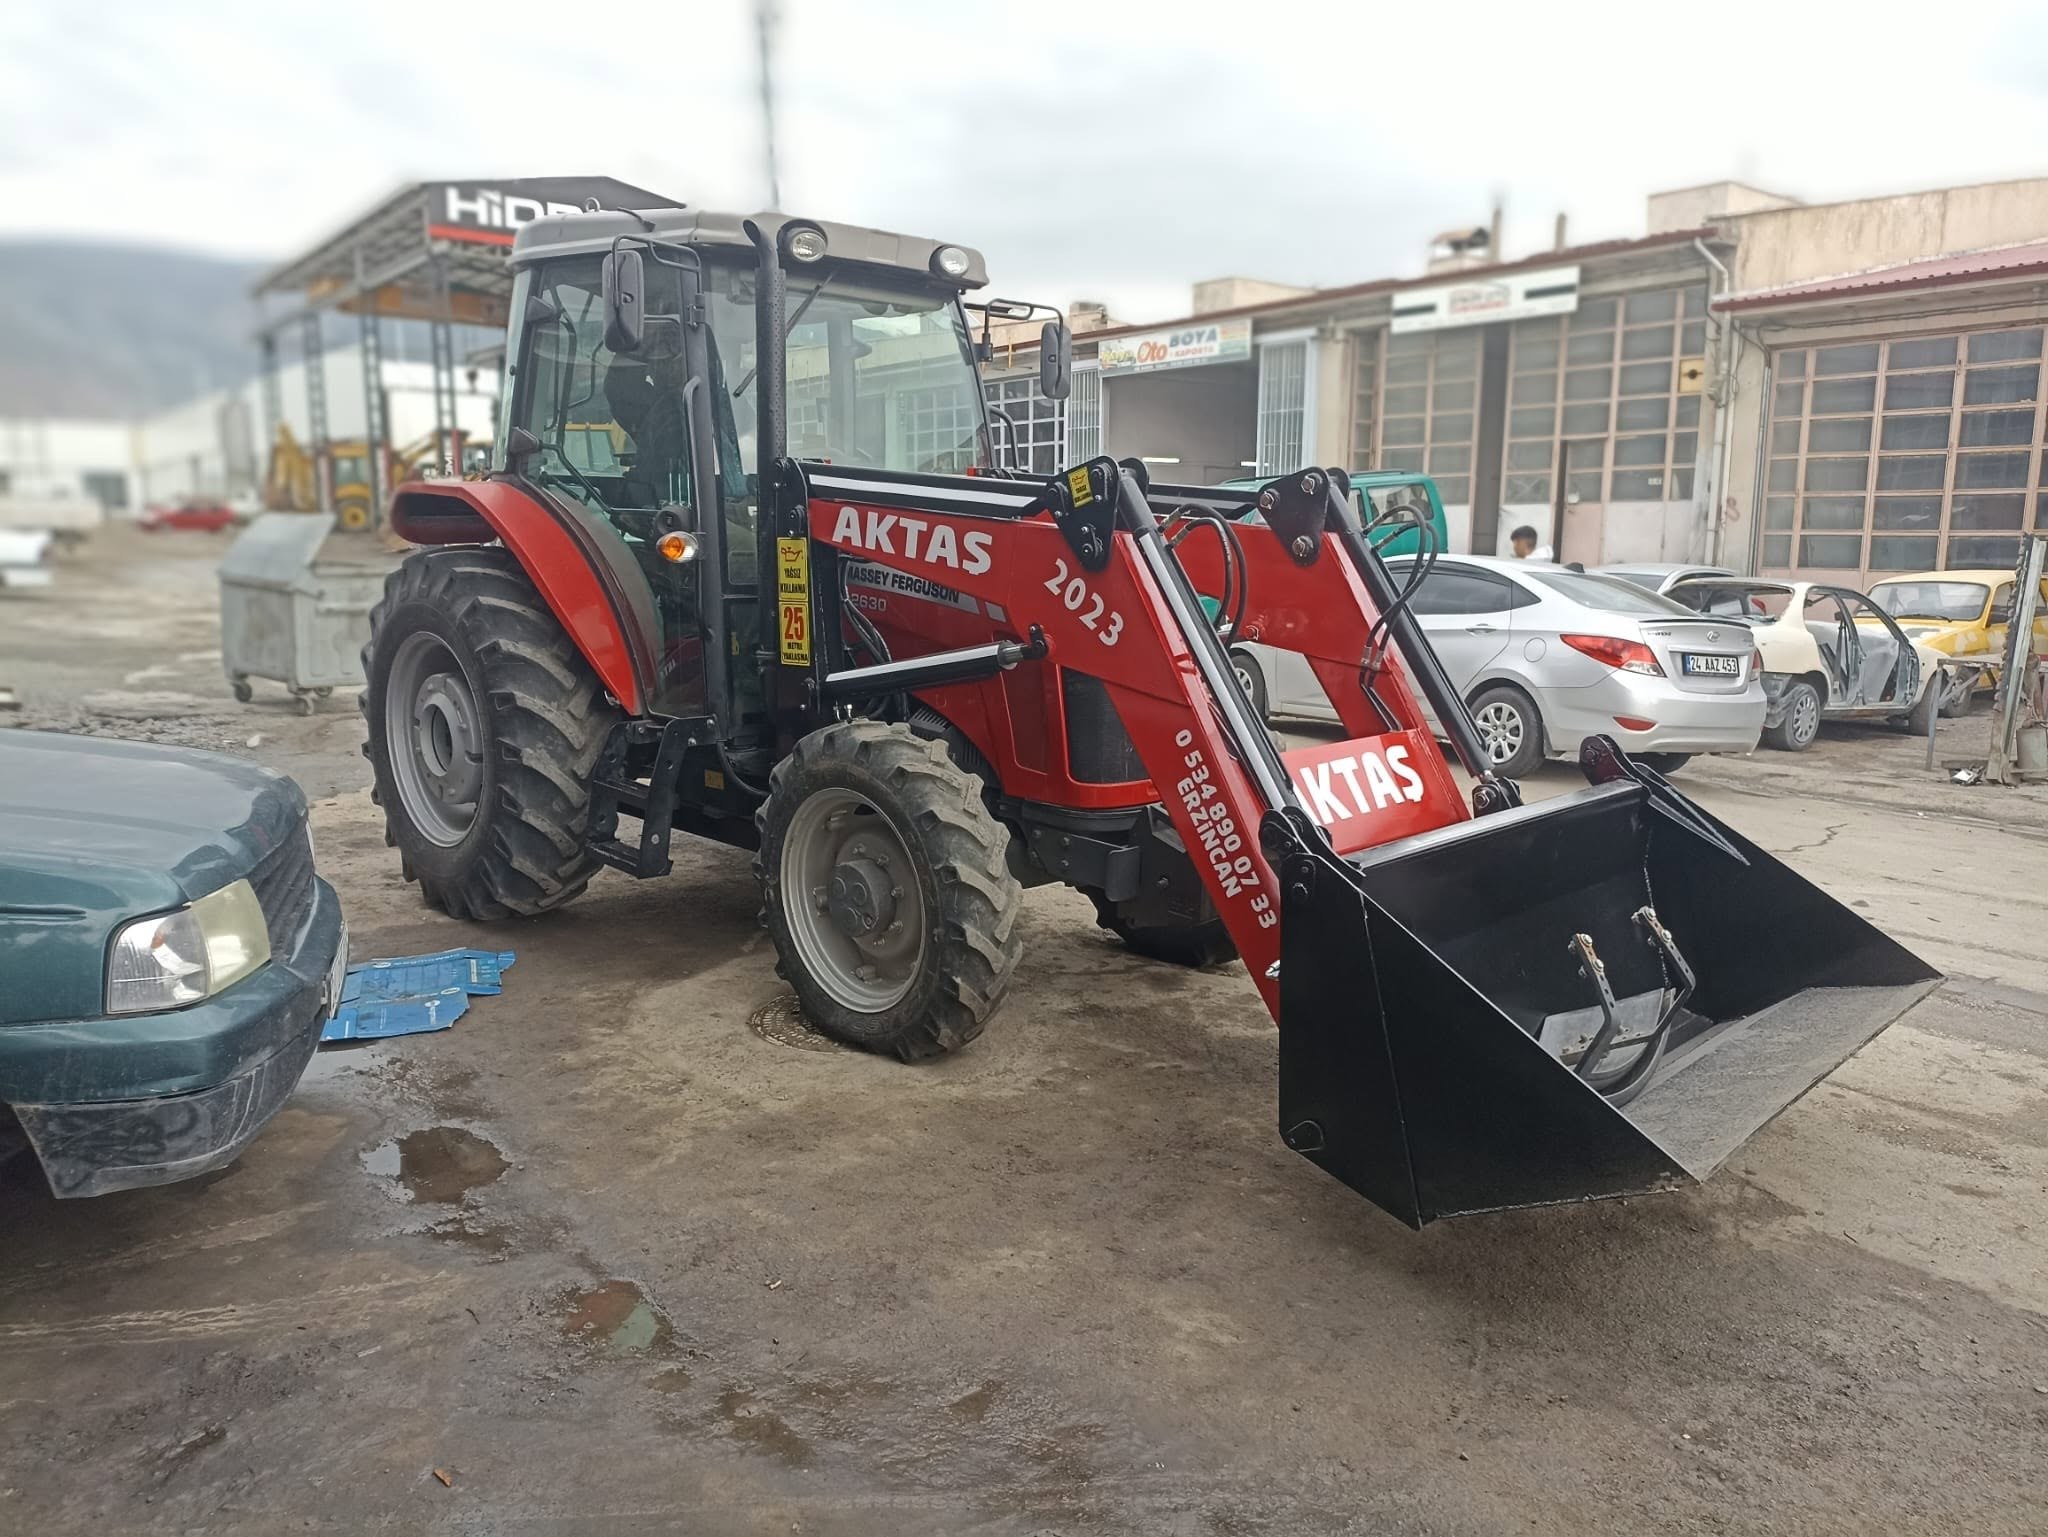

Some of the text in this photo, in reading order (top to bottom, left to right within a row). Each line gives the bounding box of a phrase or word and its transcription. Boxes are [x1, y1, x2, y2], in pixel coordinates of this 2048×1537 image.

[1137, 341, 1168, 363] Oto
[1169, 328, 1217, 348] BOYA
[832, 506, 993, 576] AKTAŞ
[891, 572, 960, 604] FERGUSON
[1043, 558, 1124, 646] 2023
[783, 606, 805, 641] 25
[1690, 656, 1737, 672] 24 AAZ 453
[1175, 729, 1278, 929] 0 534 890 07 33
